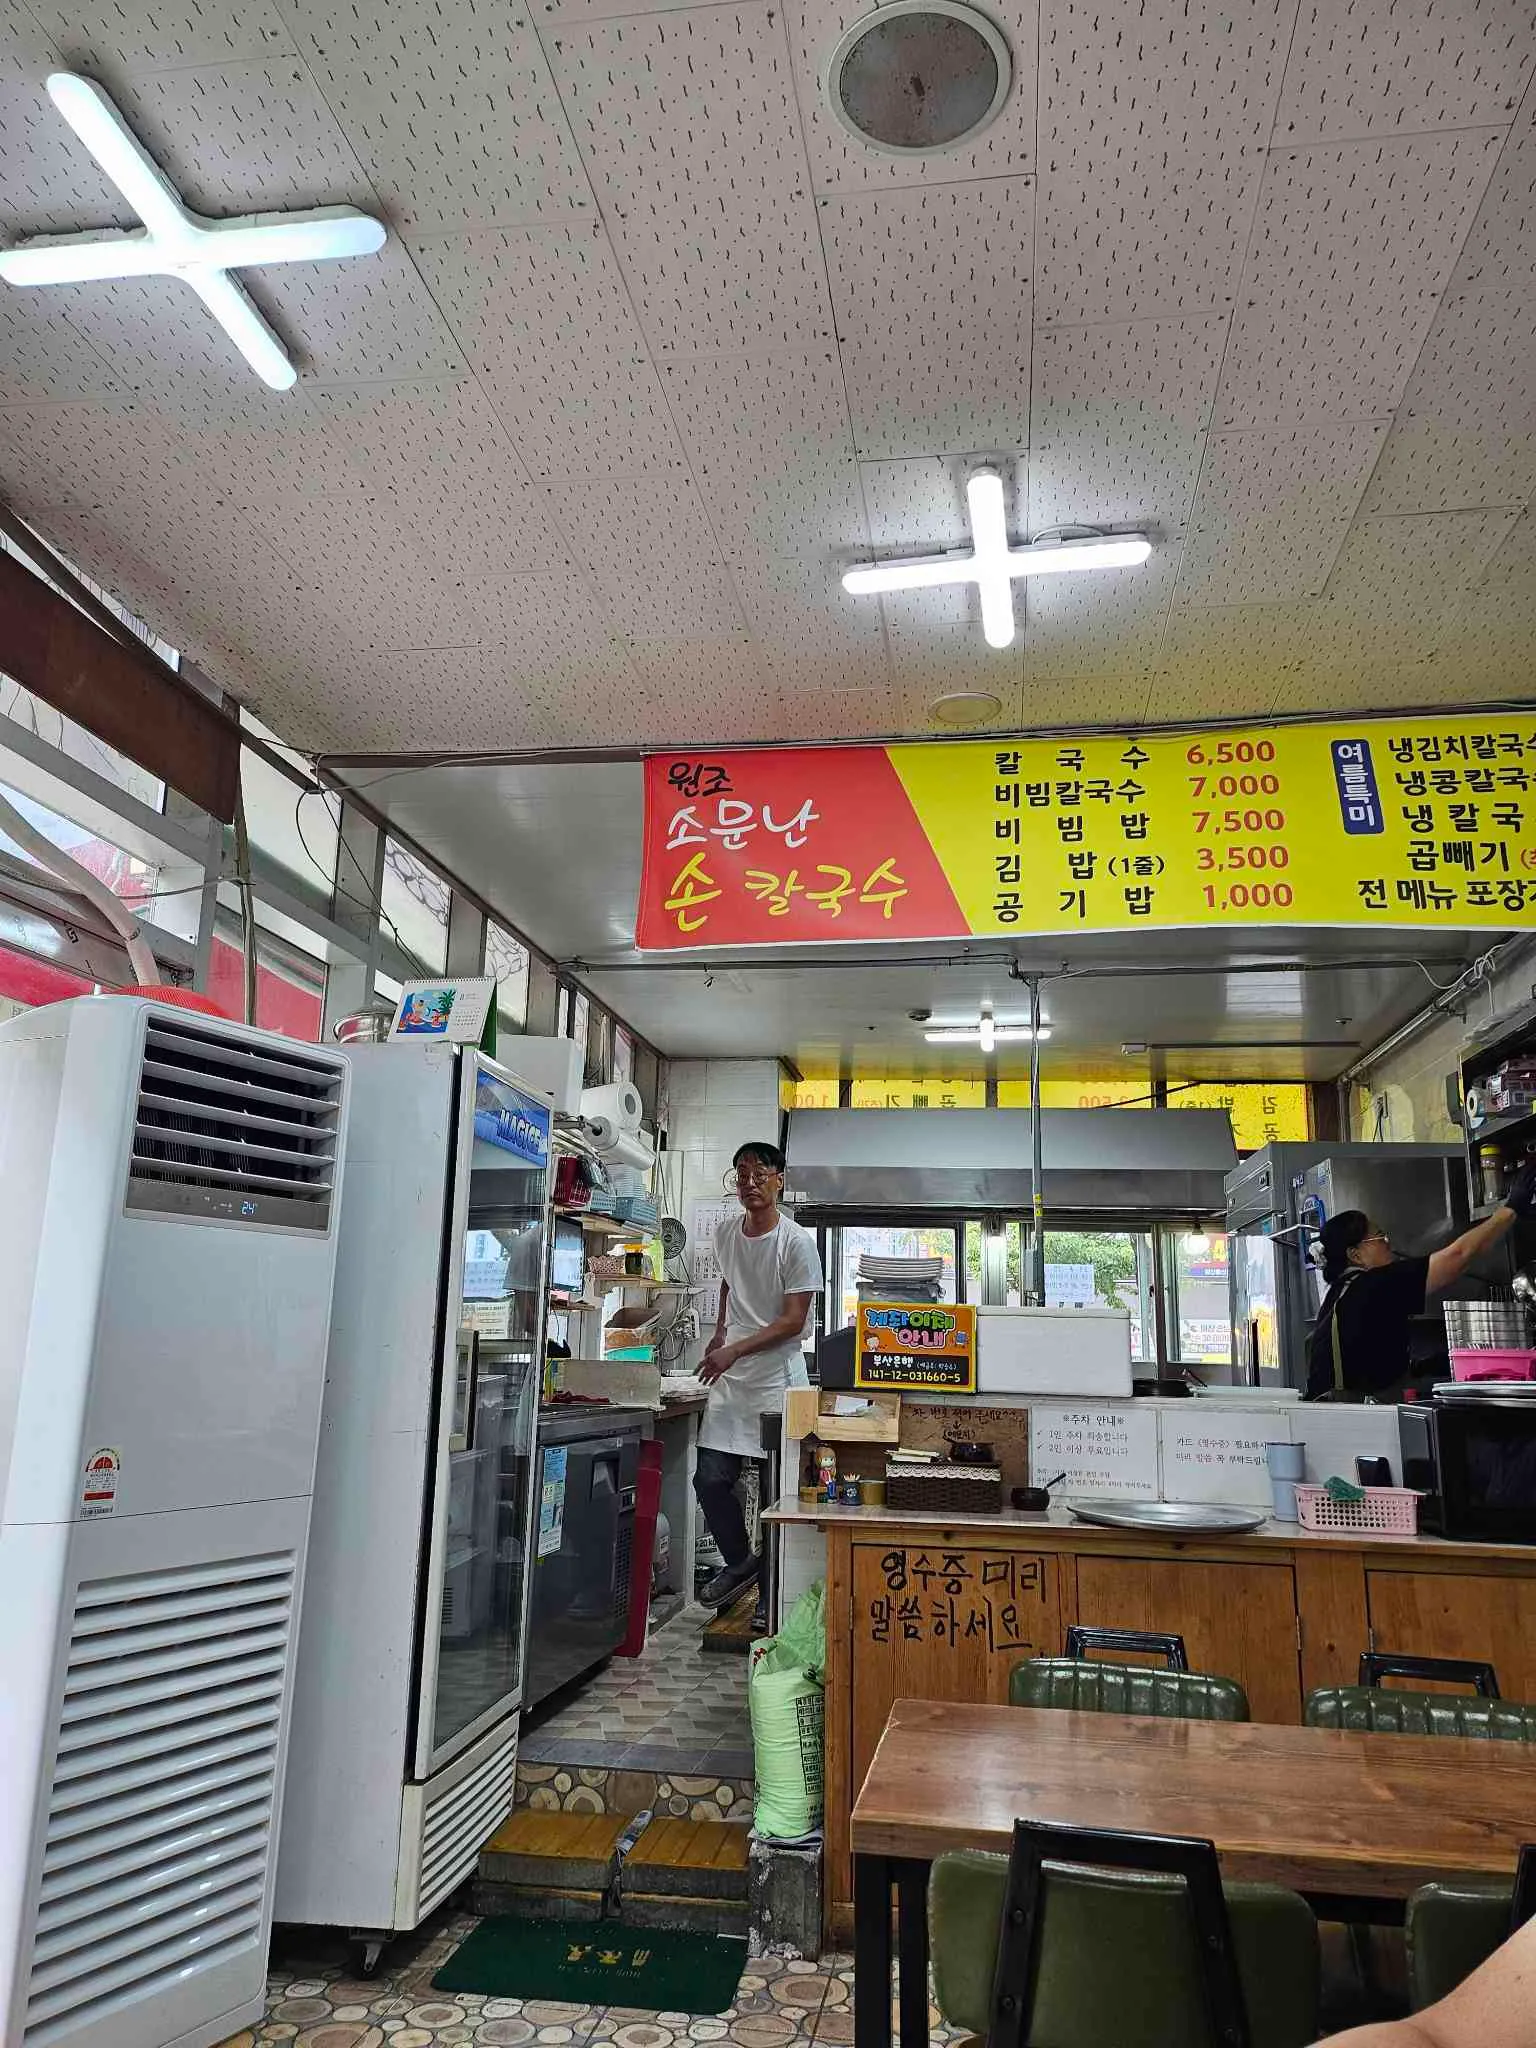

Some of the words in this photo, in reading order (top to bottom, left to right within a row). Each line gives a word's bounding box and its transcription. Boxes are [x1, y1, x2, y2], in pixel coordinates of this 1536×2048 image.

[1186, 740, 1275, 766] 6,500
[668, 762, 734, 798] 원조
[994, 778, 1146, 808] 비빔칼국수
[1188, 774, 1280, 799] 7,000
[1338, 743, 1375, 827] 여름특미
[1394, 767, 1536, 796] 냉콩칼국
[666, 798, 820, 850] 소문난
[1192, 809, 1285, 835] 7,500
[1108, 855, 1165, 877] (1줄)
[1197, 845, 1289, 872] 3,500
[1406, 840, 1510, 872] 곱빼기
[664, 852, 723, 932] 손
[744, 857, 908, 919] 칼국수
[1202, 883, 1293, 910] 1,000
[866, 1310, 954, 1329] 계좌이체
[898, 1328, 945, 1347] 안내
[868, 1369, 961, 1383] 141-12-031660-5
[873, 1355, 914, 1368] 부산은행
[1066, 1444, 1082, 1454] 이상
[881, 1550, 974, 1595] 영수증
[982, 1555, 1046, 1603] 미리
